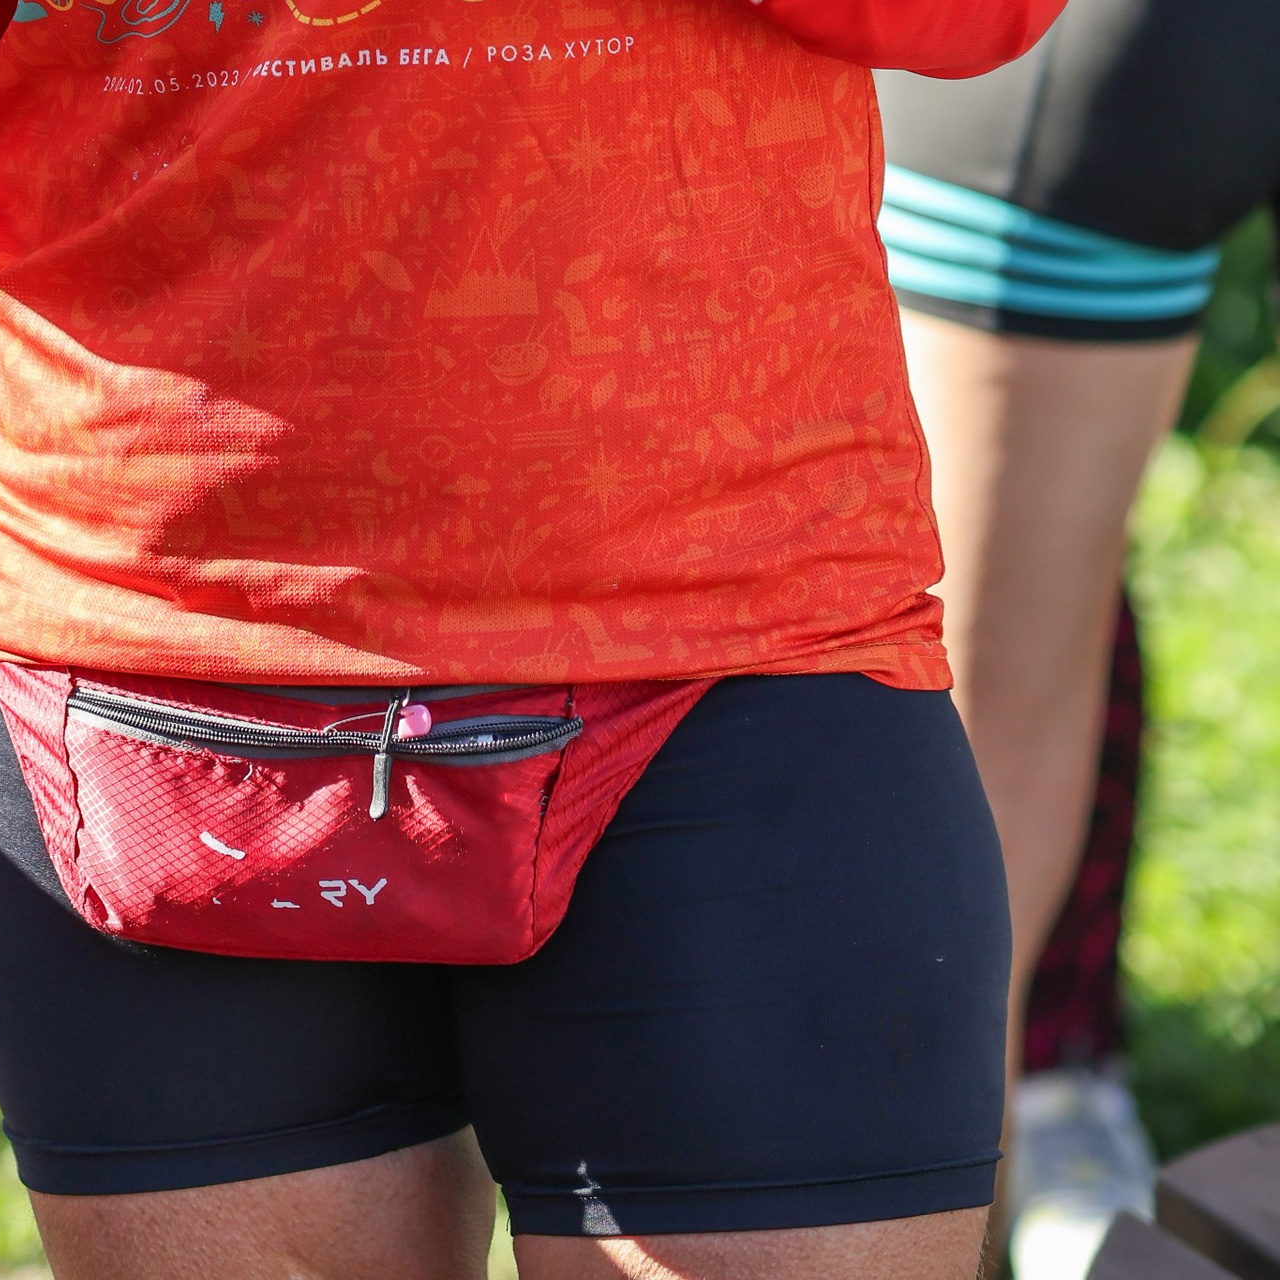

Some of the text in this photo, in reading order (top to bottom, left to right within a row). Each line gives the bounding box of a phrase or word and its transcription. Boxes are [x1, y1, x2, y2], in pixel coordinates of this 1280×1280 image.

[399, 47, 451, 68] БЕГА
[486, 42, 554, 64] РОЗА
[563, 36, 636, 59] ХУТОР
